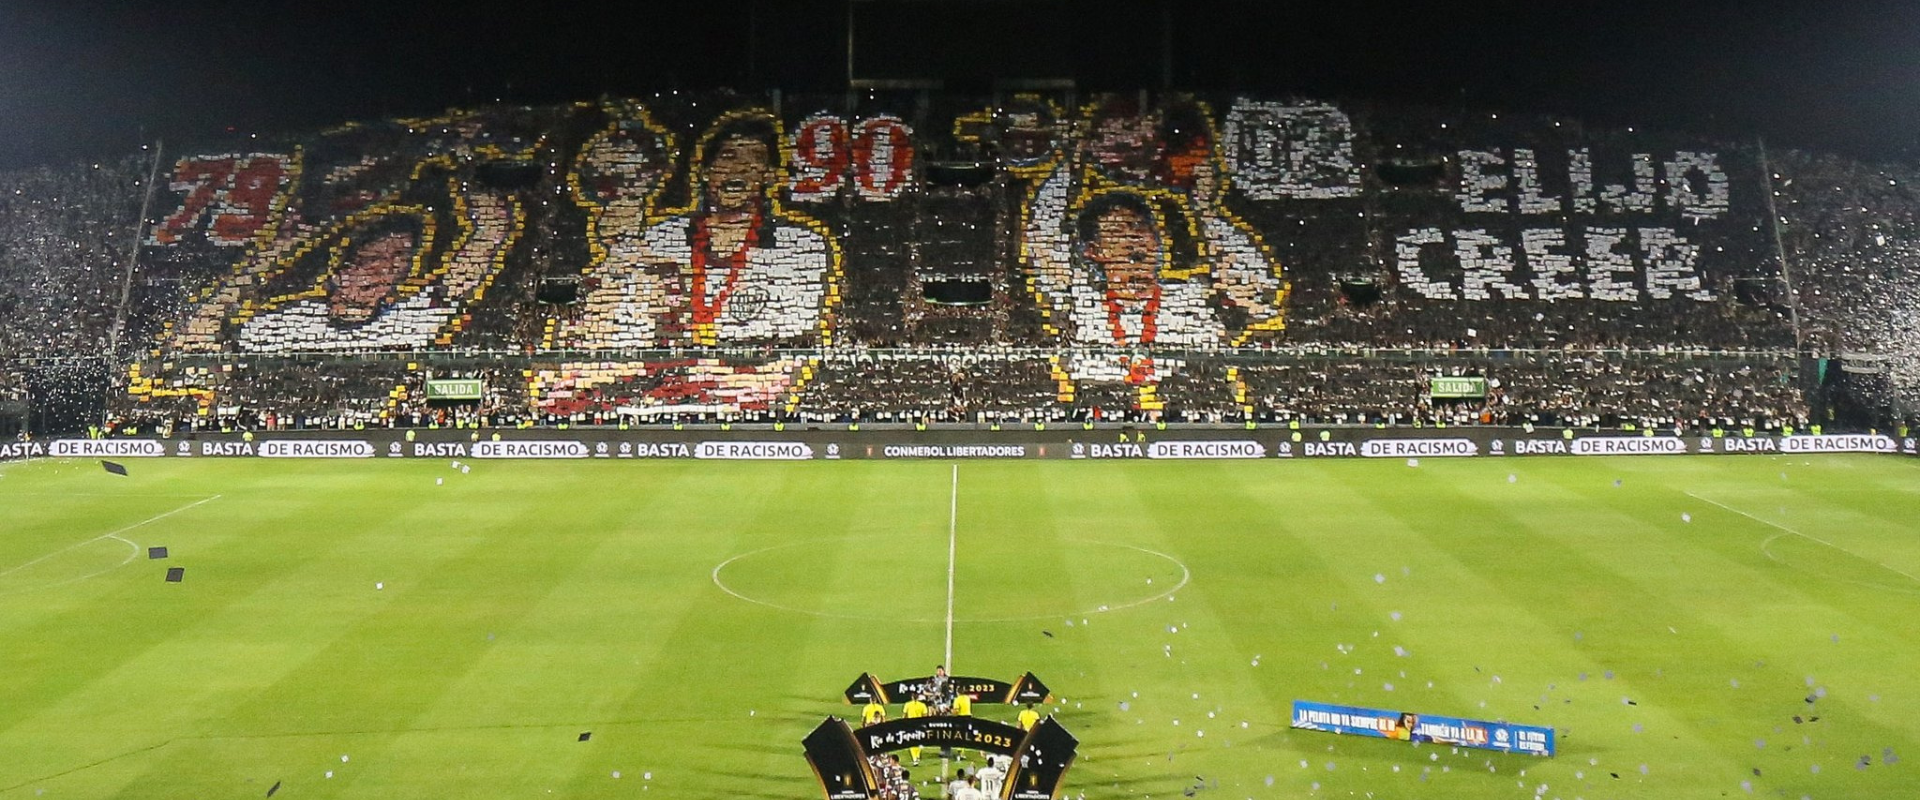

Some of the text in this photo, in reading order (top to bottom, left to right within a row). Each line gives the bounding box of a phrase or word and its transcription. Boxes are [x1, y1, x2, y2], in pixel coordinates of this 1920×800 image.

[789, 111, 914, 202] 90
[144, 153, 291, 246] 79
[1396, 227, 1717, 301] CREER
[434, 384, 474, 395] SALIDA
[1438, 382, 1477, 393] SALIDA
[0, 441, 155, 456] ASTA DE RACISMO
[202, 442, 364, 456] BASTA DE RACISMO
[414, 442, 579, 456] BASTA DE RACISMO
[637, 443, 803, 457] BASTA DE RACISMO
[884, 446, 1025, 457] CONMEBOL LIBERTADORES
[1090, 443, 1256, 457] BASTA DE RACISMO
[1304, 442, 1468, 456] BASTA DE RACISMO
[1515, 439, 1677, 454] BASTA DE RACISMO
[1725, 437, 1887, 452] BASTA DE RACISMO
[969, 684, 995, 692] 2023
[926, 730, 971, 740] FINAL
[974, 733, 1011, 747] 2023
[986, 780, 993, 791] 11
